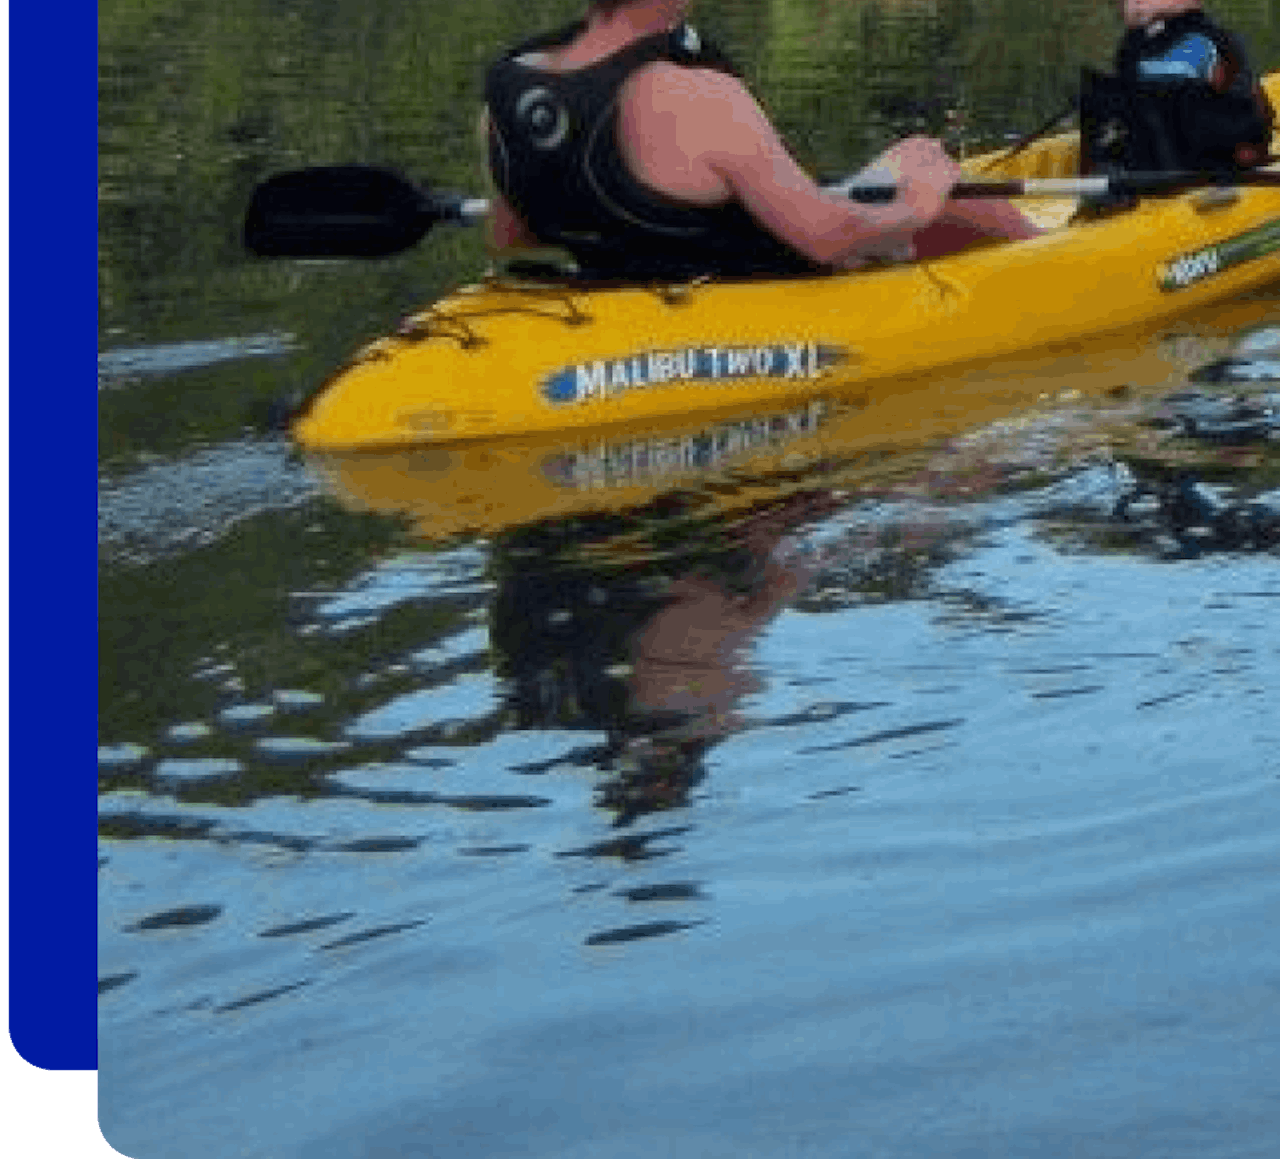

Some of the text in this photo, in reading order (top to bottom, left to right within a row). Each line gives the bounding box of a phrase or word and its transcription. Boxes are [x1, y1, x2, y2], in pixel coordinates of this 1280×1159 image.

[575, 343, 819, 399] MALIBU TWO XL
